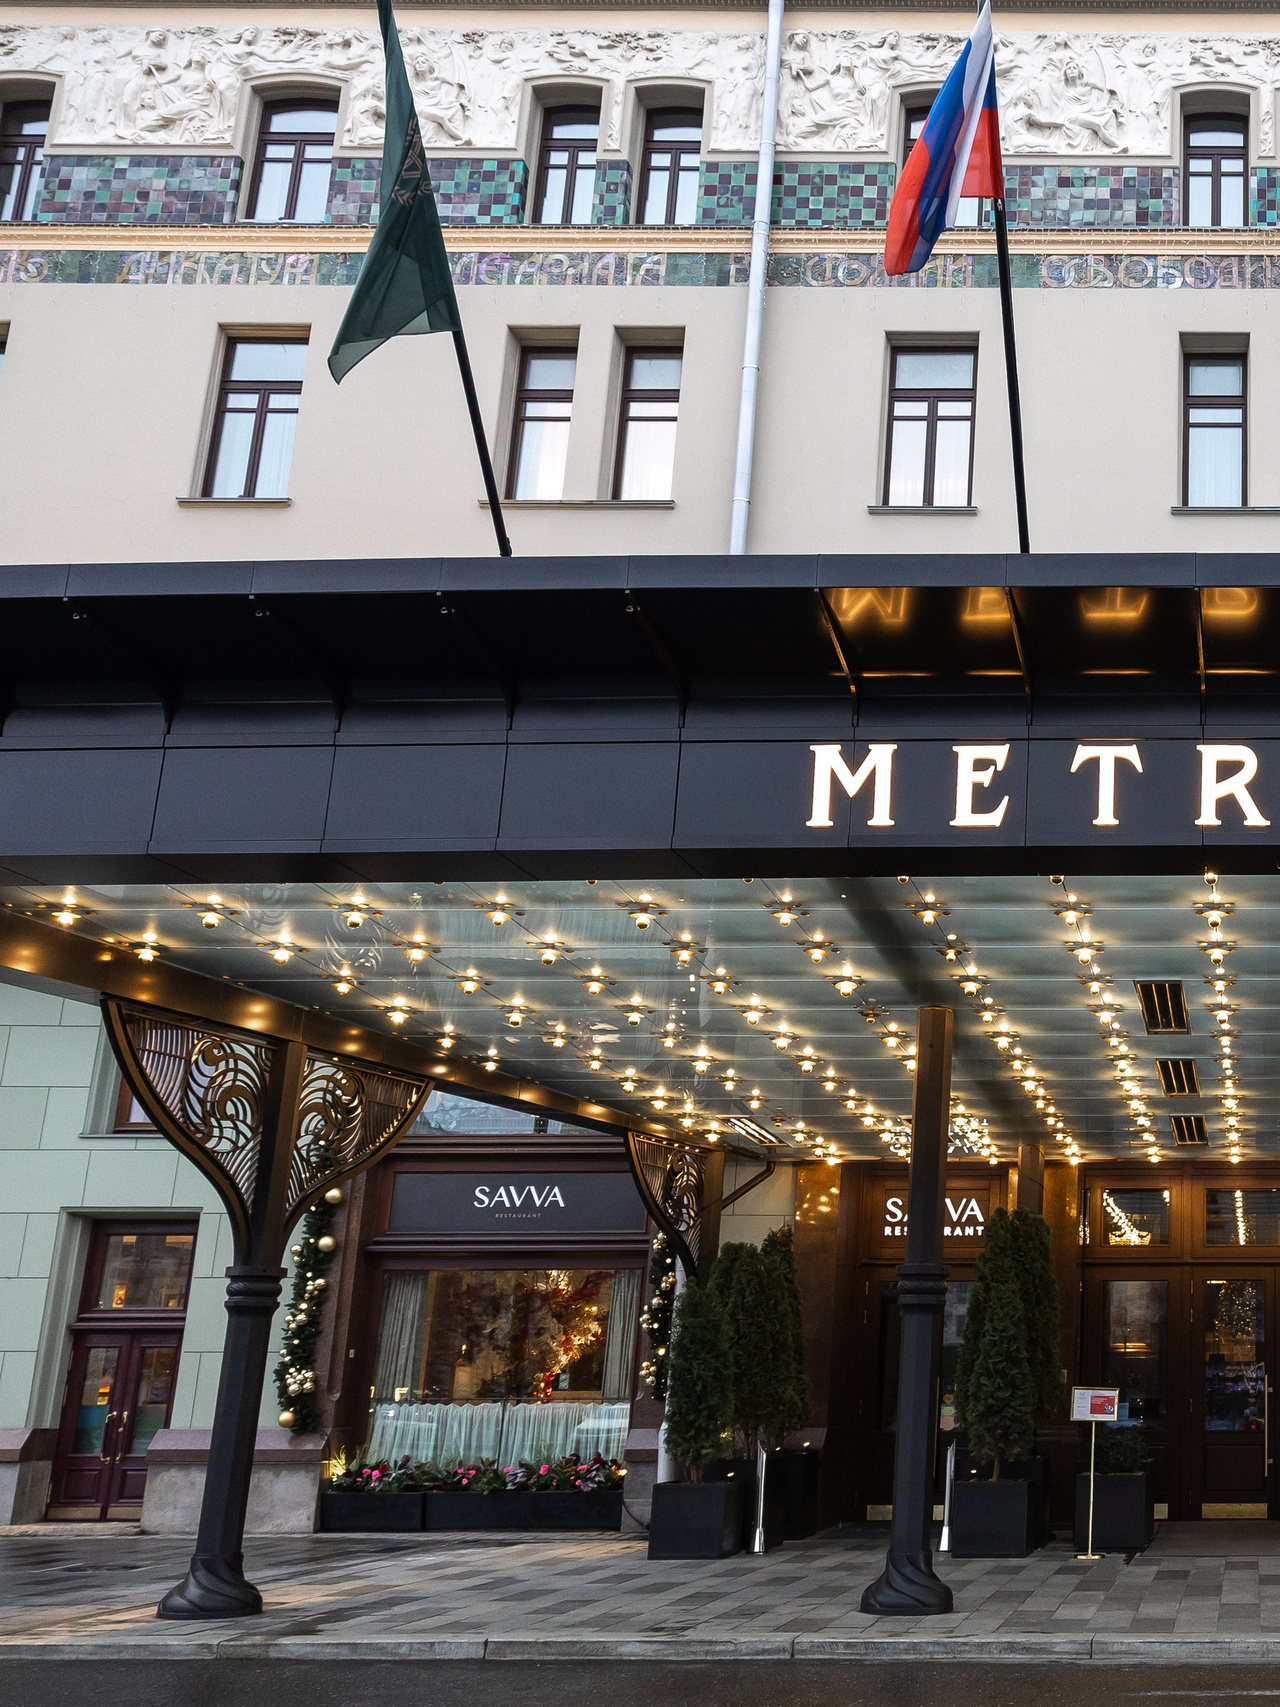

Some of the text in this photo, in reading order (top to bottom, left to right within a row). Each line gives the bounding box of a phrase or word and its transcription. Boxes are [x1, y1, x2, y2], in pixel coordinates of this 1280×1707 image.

[473, 1186, 565, 1208] SAVVA
[885, 1197, 985, 1222] SVA
[884, 1226, 985, 1236] RERANT
